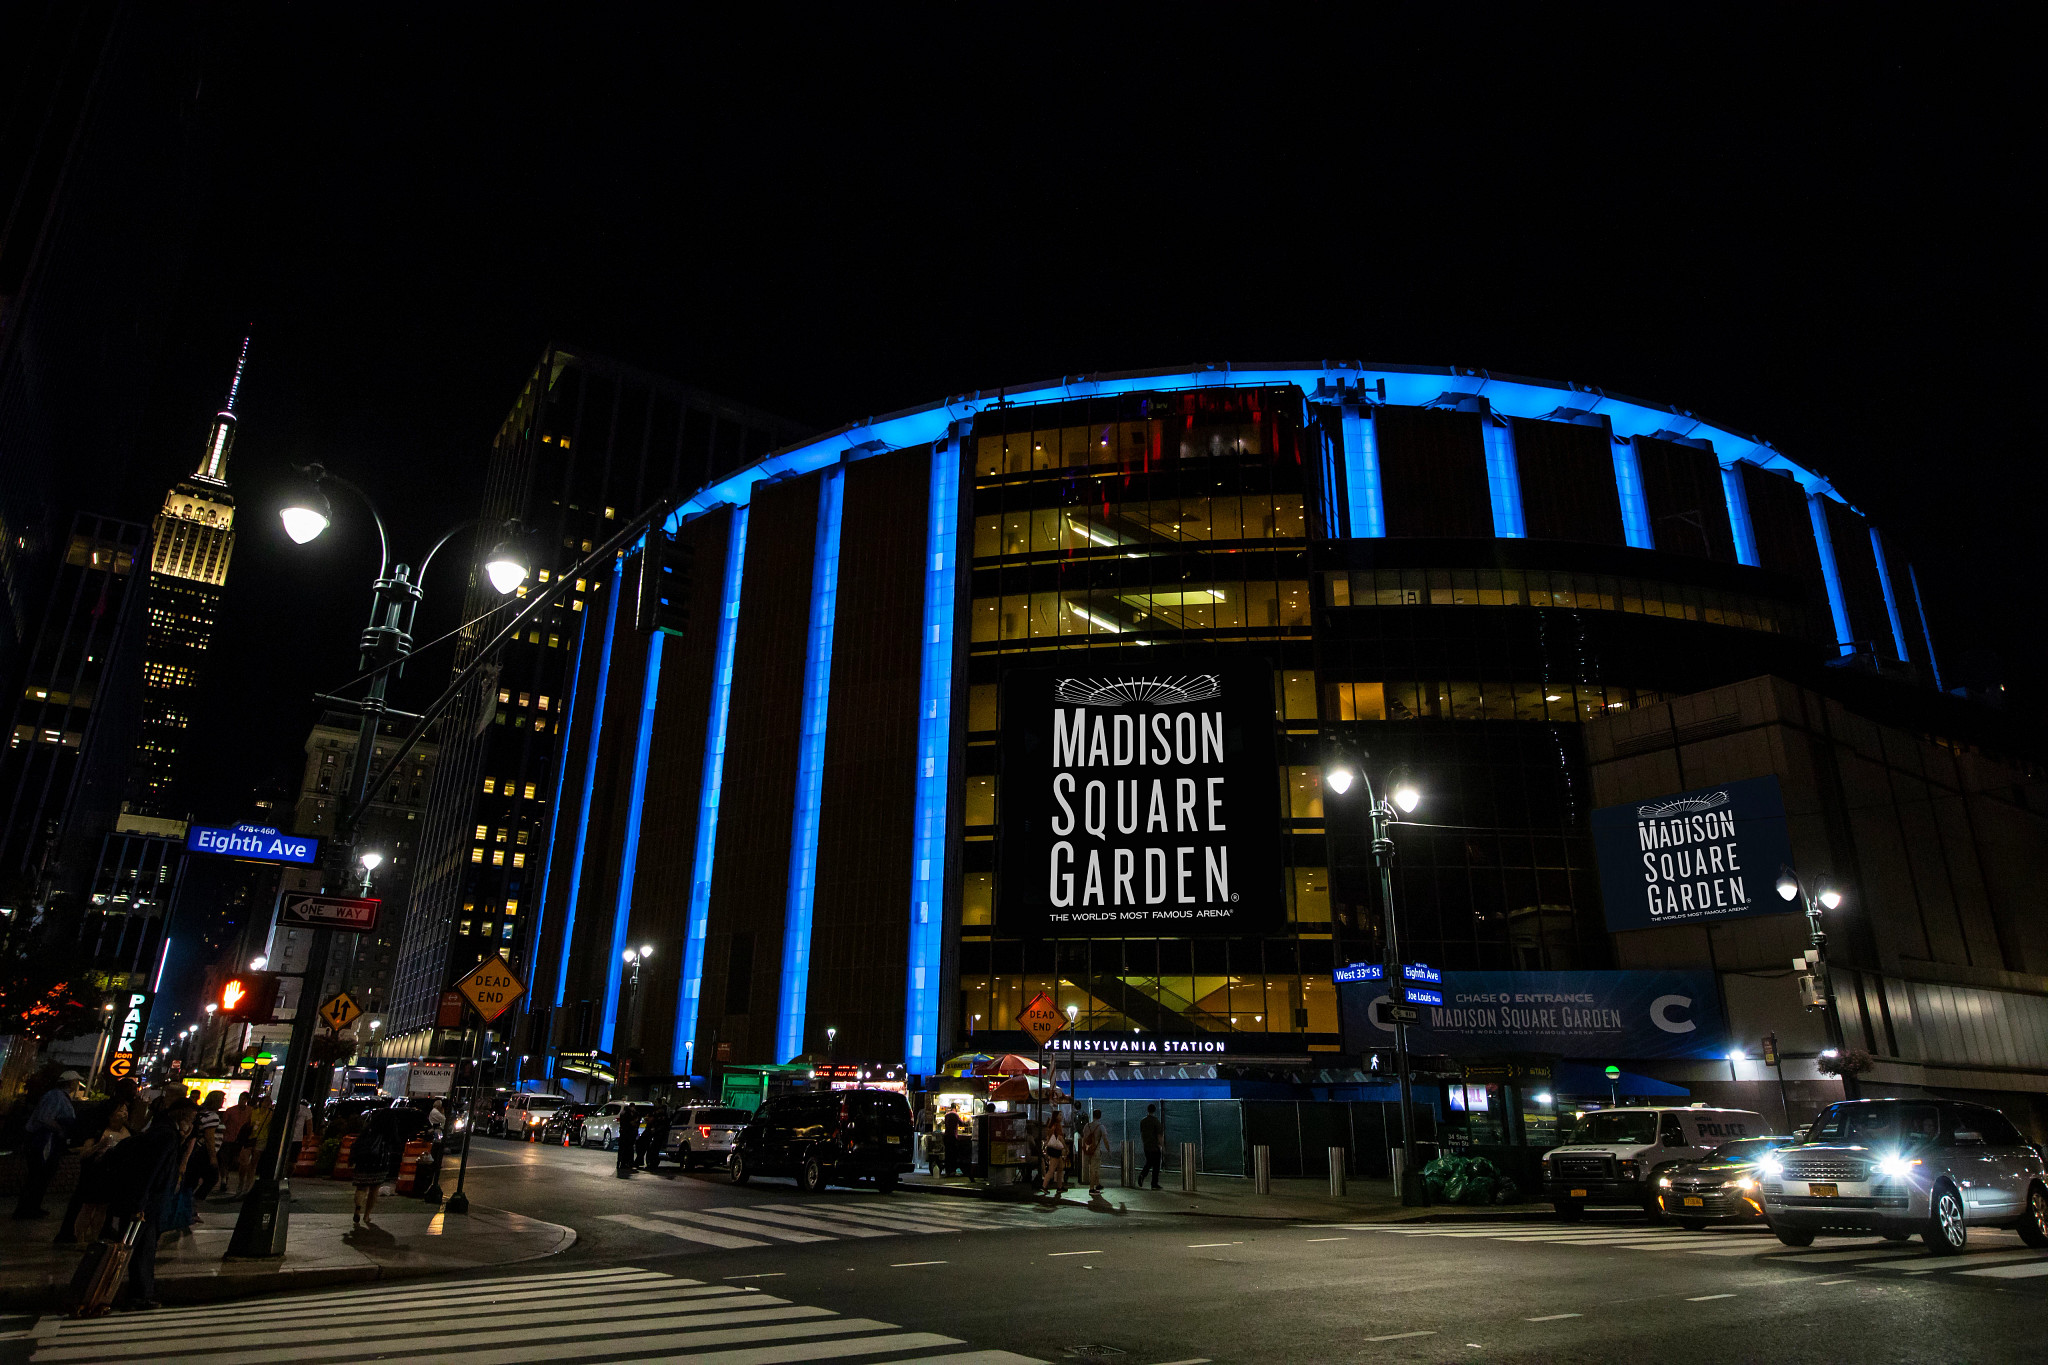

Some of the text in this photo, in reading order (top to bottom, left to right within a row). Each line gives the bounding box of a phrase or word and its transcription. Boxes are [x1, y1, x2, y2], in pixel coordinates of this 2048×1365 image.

[1053, 708, 1224, 768] MADISON
[1051, 772, 1226, 841] SQUARE
[260, 827, 275, 835] 460
[1638, 809, 1736, 851] MADISON
[198, 830, 307, 857] Eighth Ave
[1643, 842, 1741, 883] SQUARE
[300, 904, 362, 918] ONE WAY
[1049, 914, 1069, 922] THE
[1071, 912, 1117, 921] WORLD'S
[1120, 911, 1149, 920] MOST
[1152, 910, 1193, 919] FAMOUS
[1704, 908, 1727, 916] FAMOUS
[1336, 967, 1381, 980] West 33rd St
[1405, 967, 1439, 980] Eighth Ave
[475, 975, 511, 987] DEAD
[478, 991, 503, 1003] END
[1408, 990, 1417, 1001] Joe
[1418, 992, 1432, 1002] Louis
[1456, 993, 1594, 1003] CHASE ENTRANCE
[1029, 1010, 1055, 1019] DEAD
[1430, 1006, 1622, 1029] MADISON SQUARE GARDEN
[1650, 994, 1696, 1033] C
[117, 994, 145, 1052] PARK
[1033, 1023, 1051, 1031] END
[1044, 1040, 1225, 1052] PENNSYLVANIA STATION
[1697, 1123, 1746, 1137] POLICE
